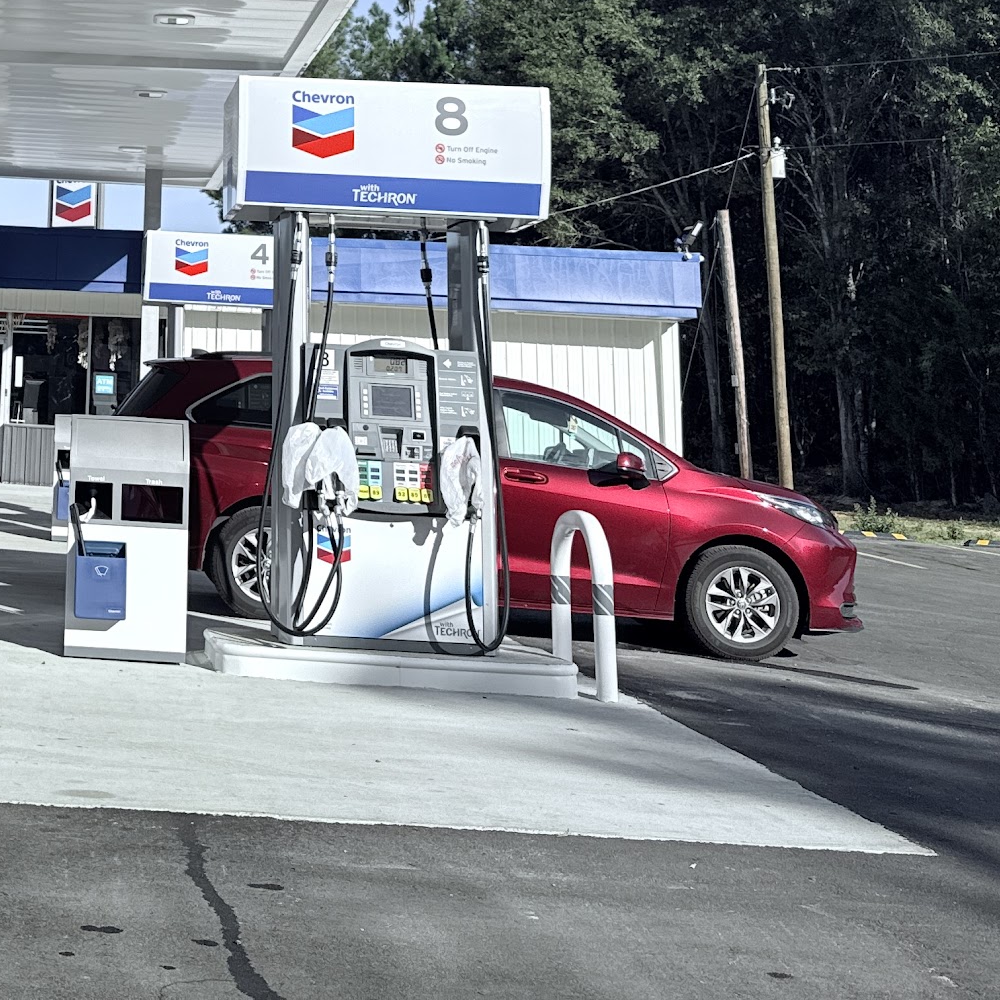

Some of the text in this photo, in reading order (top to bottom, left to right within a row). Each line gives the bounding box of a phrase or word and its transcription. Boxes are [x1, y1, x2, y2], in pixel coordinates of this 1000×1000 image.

[292, 90, 355, 105] Chevron
[435, 96, 468, 136] 8
[475, 147, 498, 155] Engine
[457, 157, 487, 166] Smoking
[360, 183, 380, 191] with
[352, 189, 417, 206] TECHRON
[175, 238, 209, 248] Chevron
[250, 243, 270, 265] 4
[206, 292, 241, 302] TECHRON
